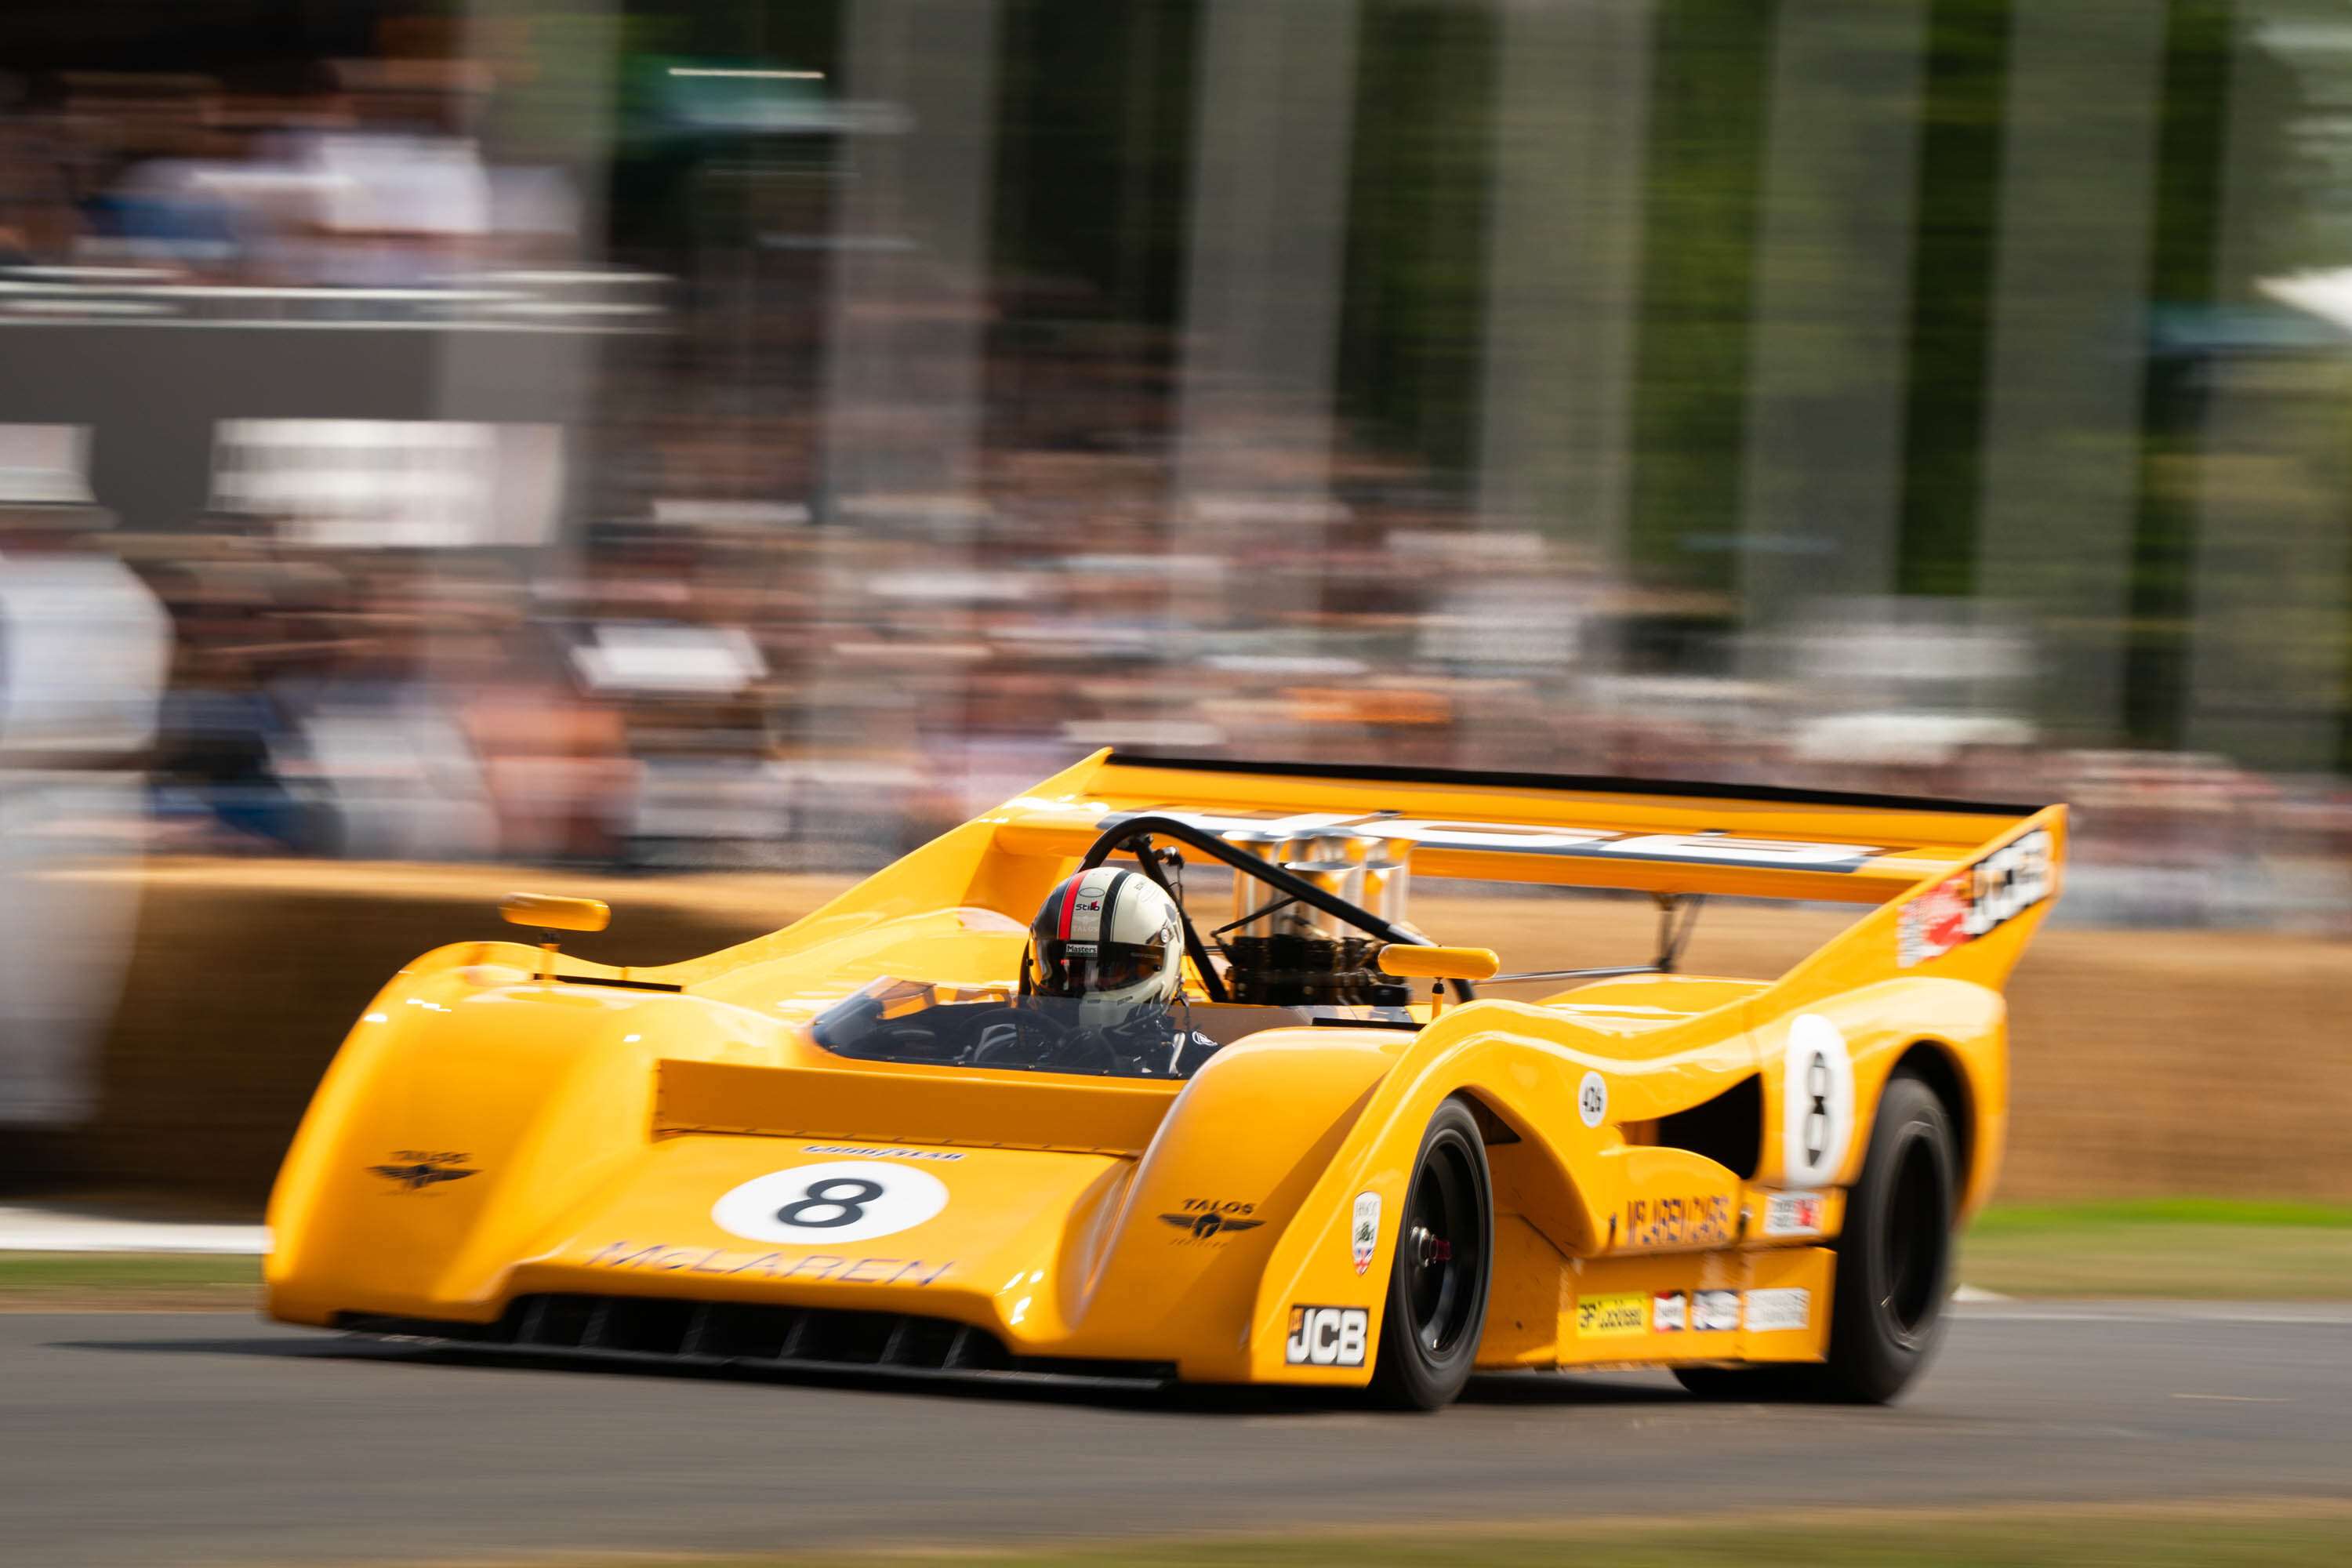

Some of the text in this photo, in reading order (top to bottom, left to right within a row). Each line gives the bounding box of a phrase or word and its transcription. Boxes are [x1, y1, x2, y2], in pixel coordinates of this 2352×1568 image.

[1067, 945, 1097, 953] Masters
[1806, 1050, 1830, 1169] 8
[776, 1178, 884, 1228] 8
[1182, 1198, 1255, 1214] TALOS
[1287, 1308, 1367, 1366] JCB
